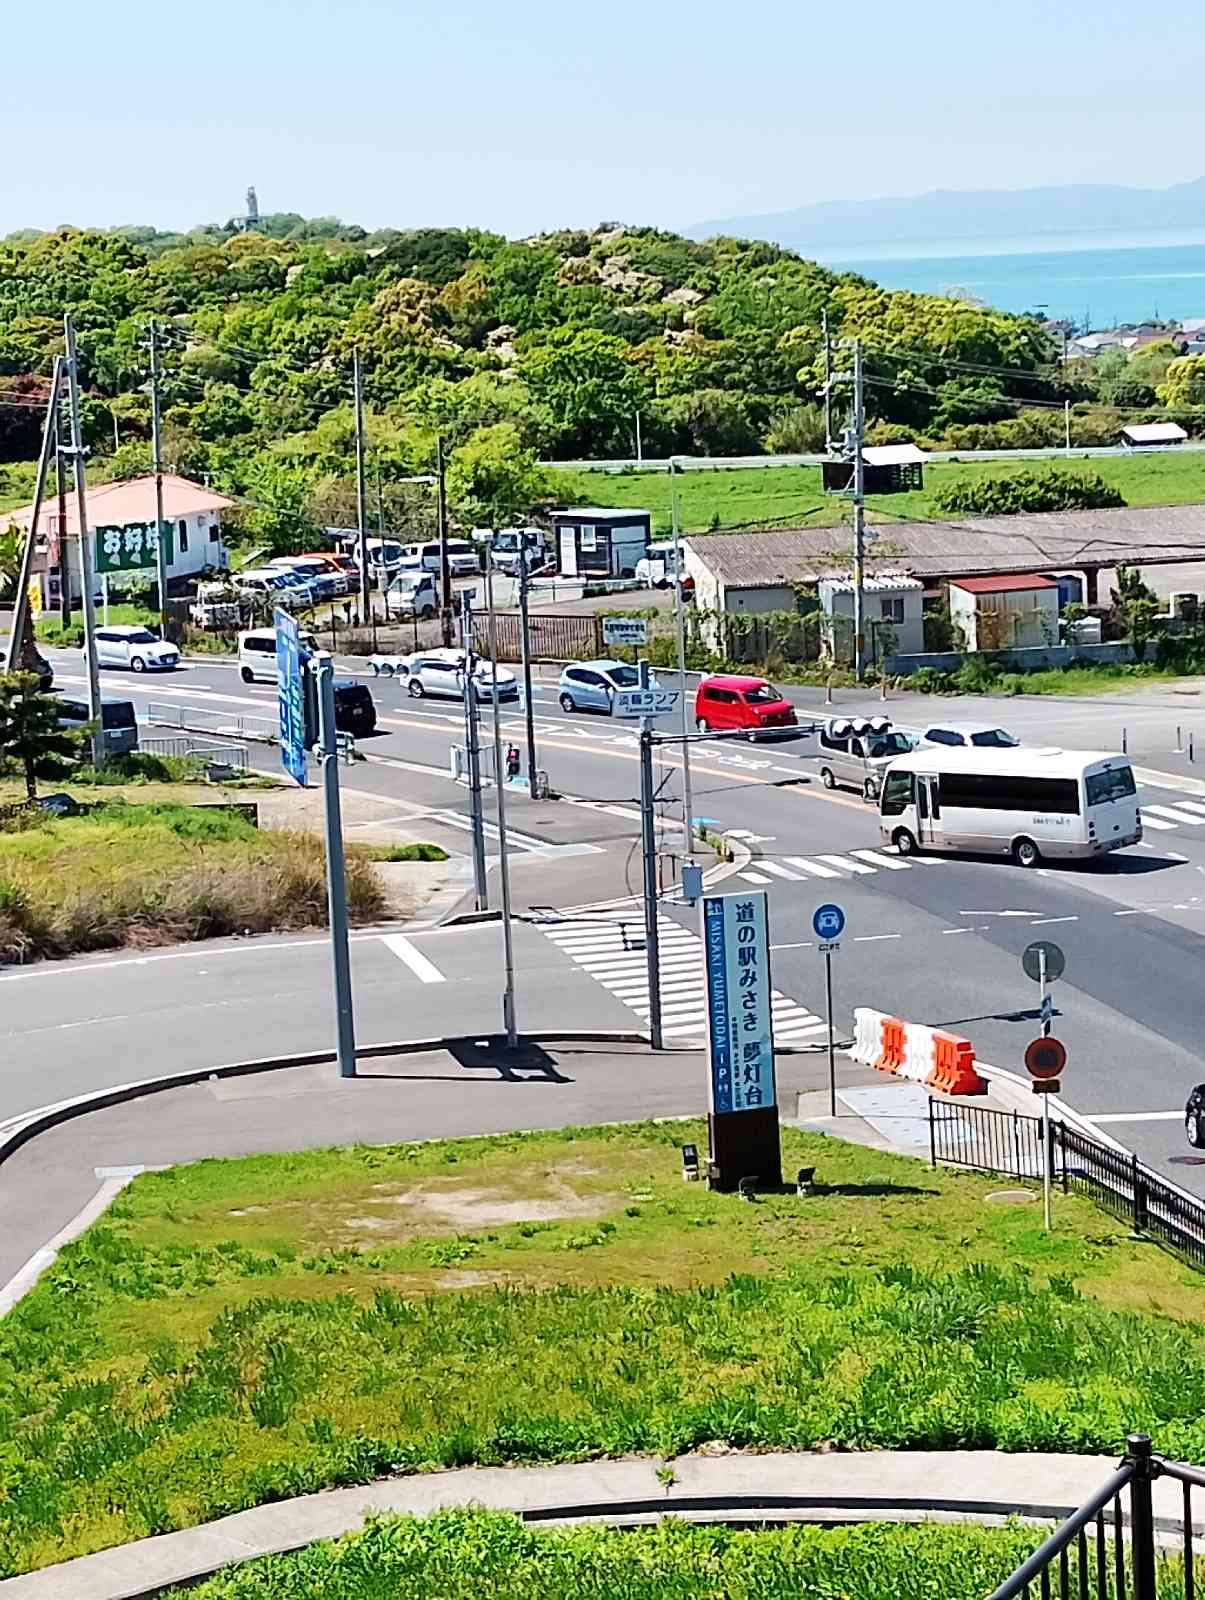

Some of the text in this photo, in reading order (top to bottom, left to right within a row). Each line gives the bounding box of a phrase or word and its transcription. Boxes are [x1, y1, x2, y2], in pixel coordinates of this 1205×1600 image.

[710, 920, 728, 1049] MISAKI YUMETODAI
[735, 901, 758, 1032] 道の駅みさき
[743, 1041, 763, 1106] 夢灯台
